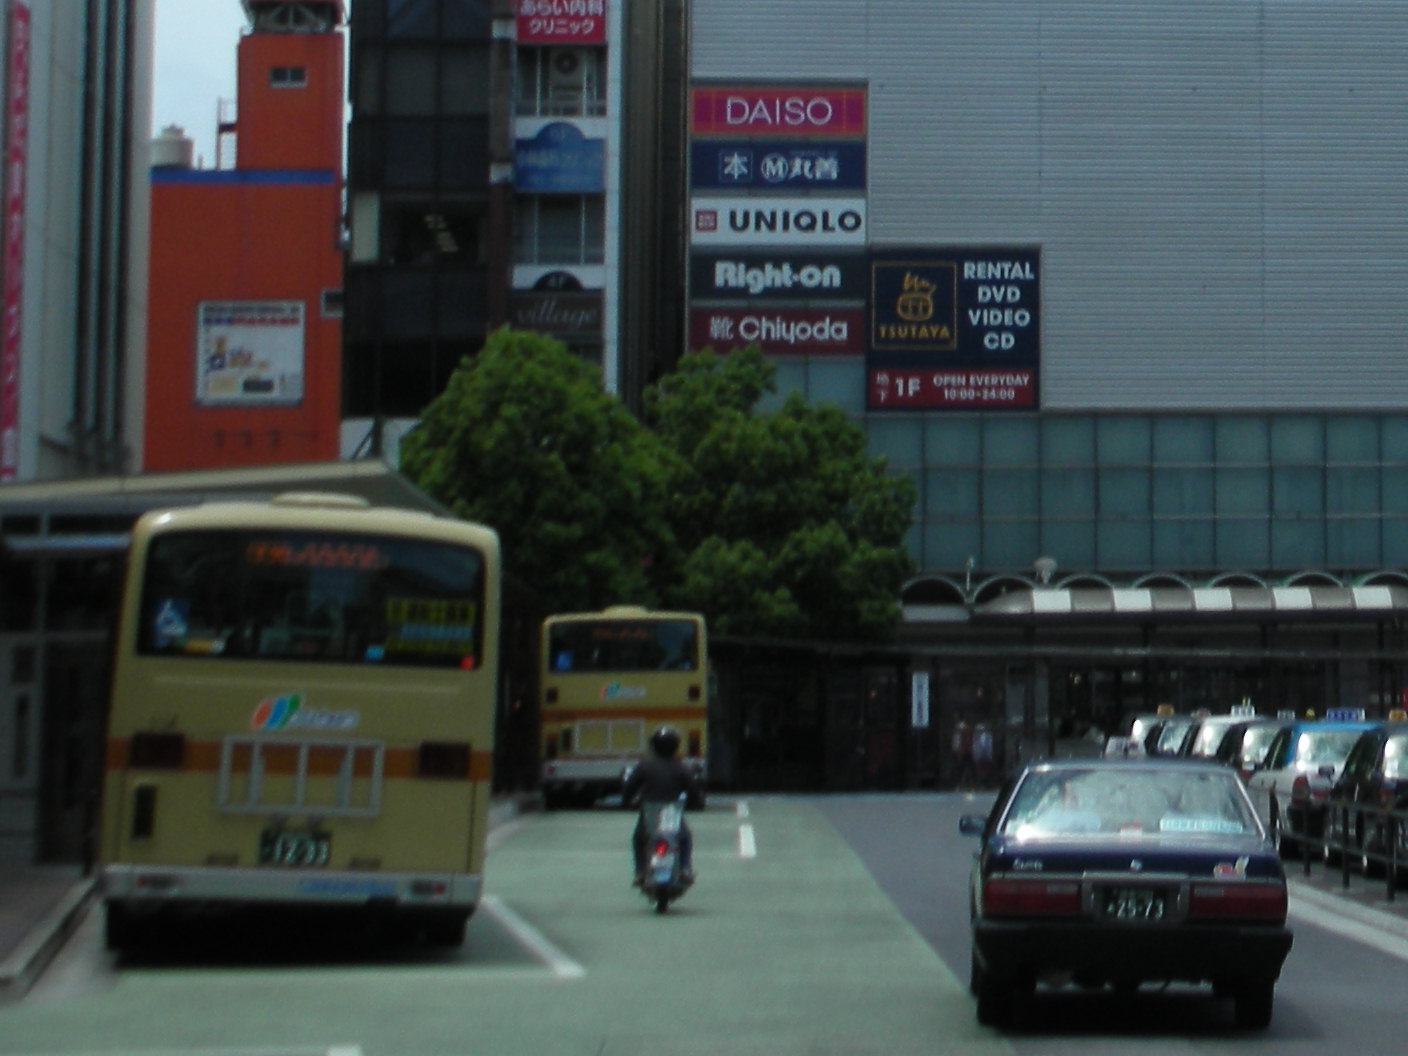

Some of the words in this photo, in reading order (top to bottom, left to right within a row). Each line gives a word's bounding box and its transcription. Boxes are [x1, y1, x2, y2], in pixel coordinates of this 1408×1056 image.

[529, 18, 595, 35] クリニック
[726, 96, 832, 125] DAISO
[723, 151, 749, 181] 本
[789, 155, 840, 181] 丸善
[729, 209, 862, 233] UNIQLO
[714, 260, 842, 294] Right-on
[963, 261, 1035, 281] RENTAL
[976, 285, 1021, 303] DVD
[967, 308, 1031, 327] VIDEO
[738, 316, 848, 344] Chiyoda
[878, 324, 950, 340] TSUTAYA
[983, 332, 1015, 350] CD
[895, 376, 921, 397] 1F
[932, 373, 966, 387] OPEN
[969, 373, 1030, 387] EVERYDAY
